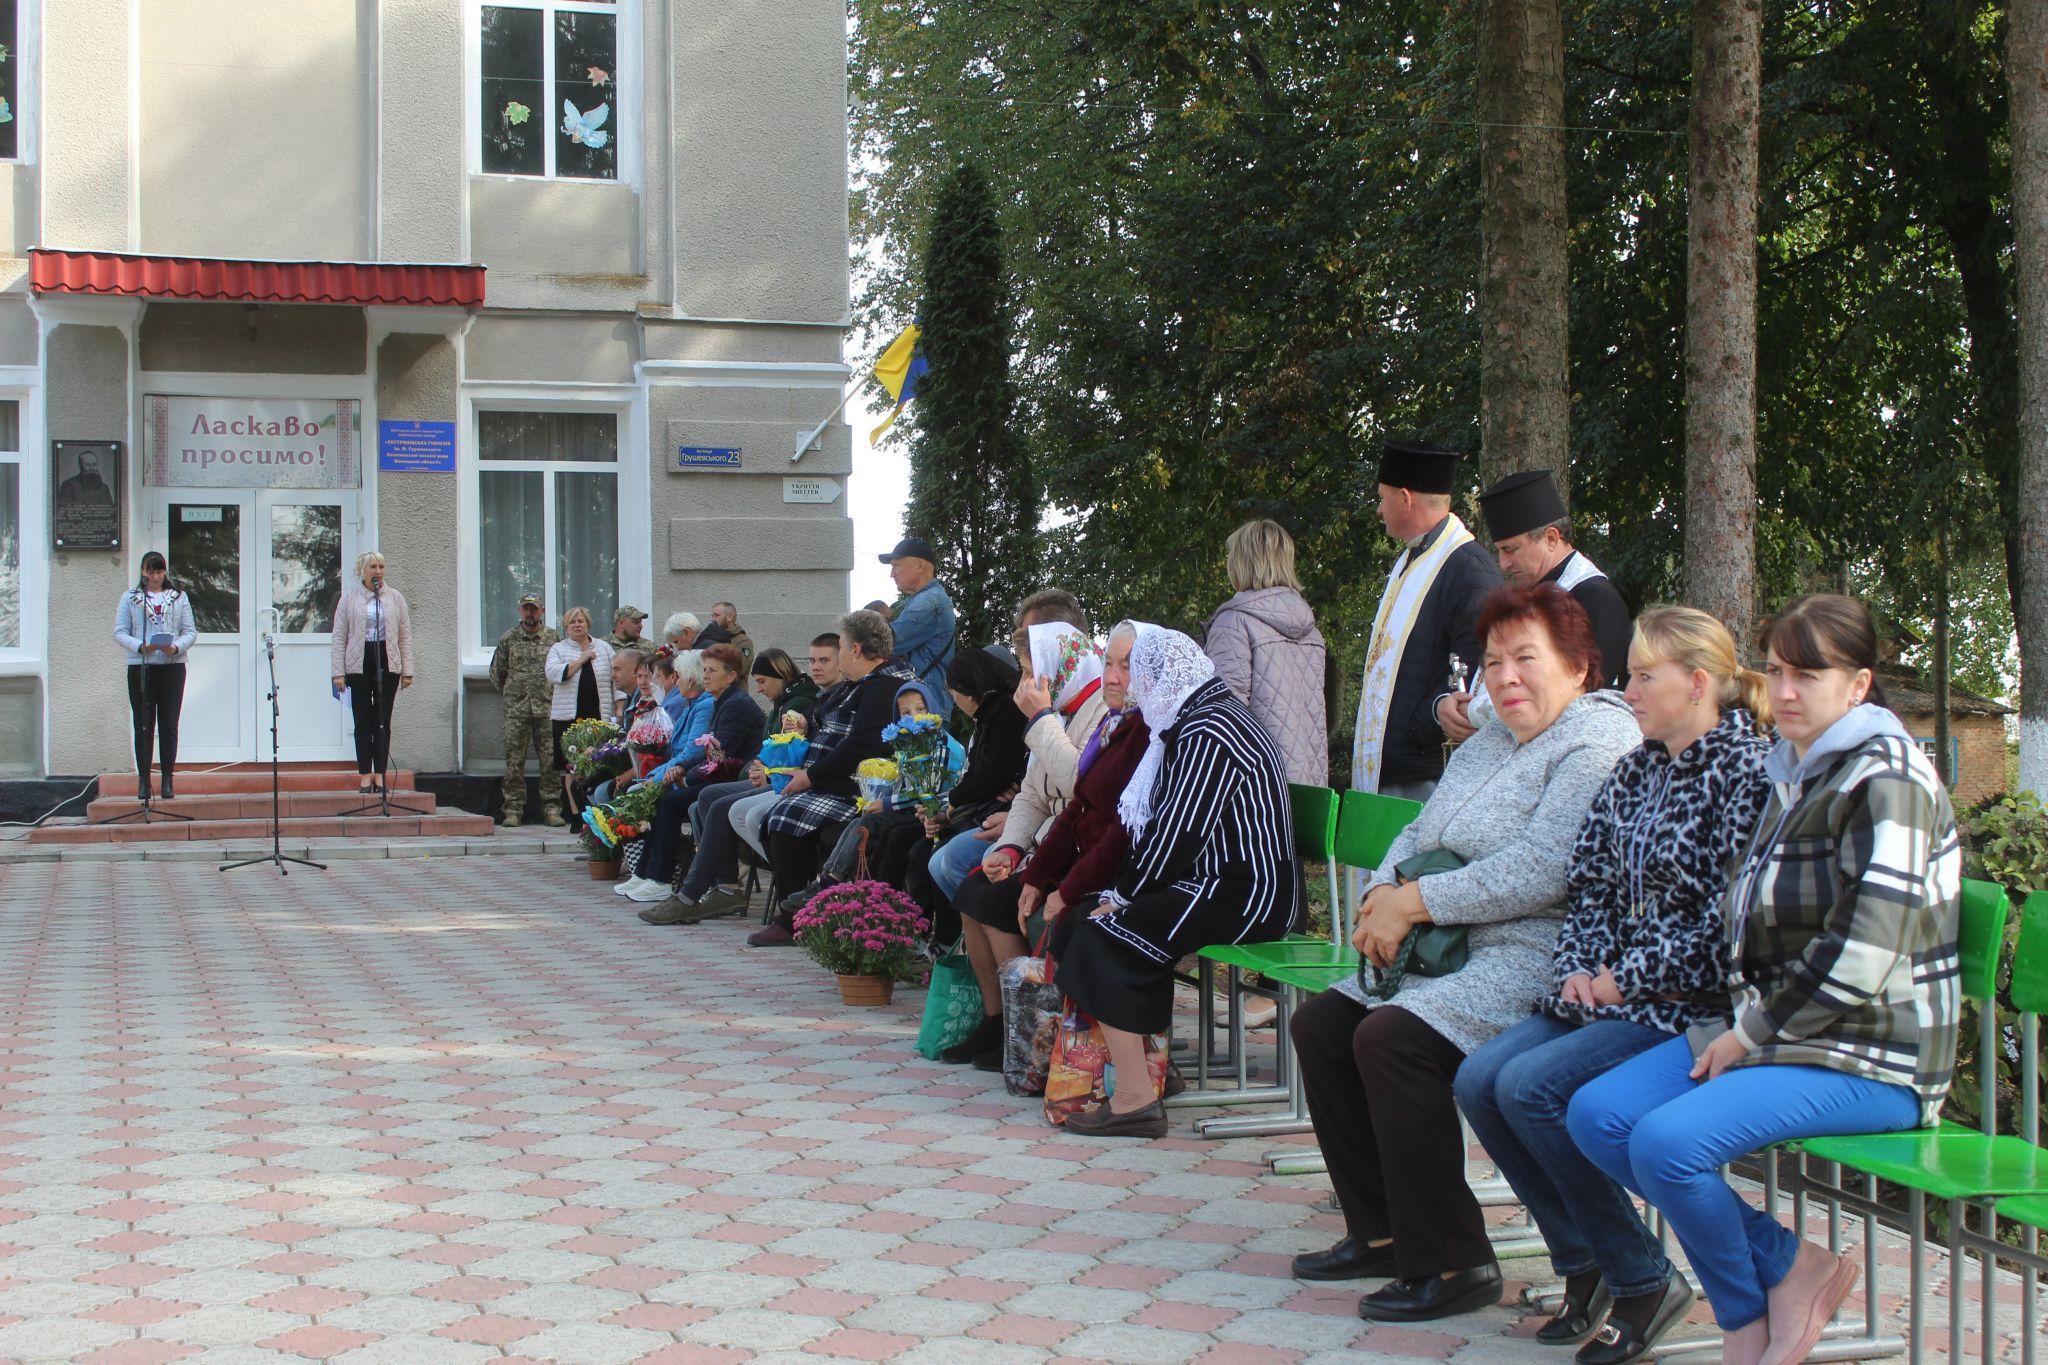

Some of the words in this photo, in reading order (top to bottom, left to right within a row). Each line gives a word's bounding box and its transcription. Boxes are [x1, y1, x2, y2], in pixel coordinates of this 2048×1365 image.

[181, 444, 326, 470] просимо!
[682, 453, 727, 462] Грушевського
[727, 451, 740, 463] 23
